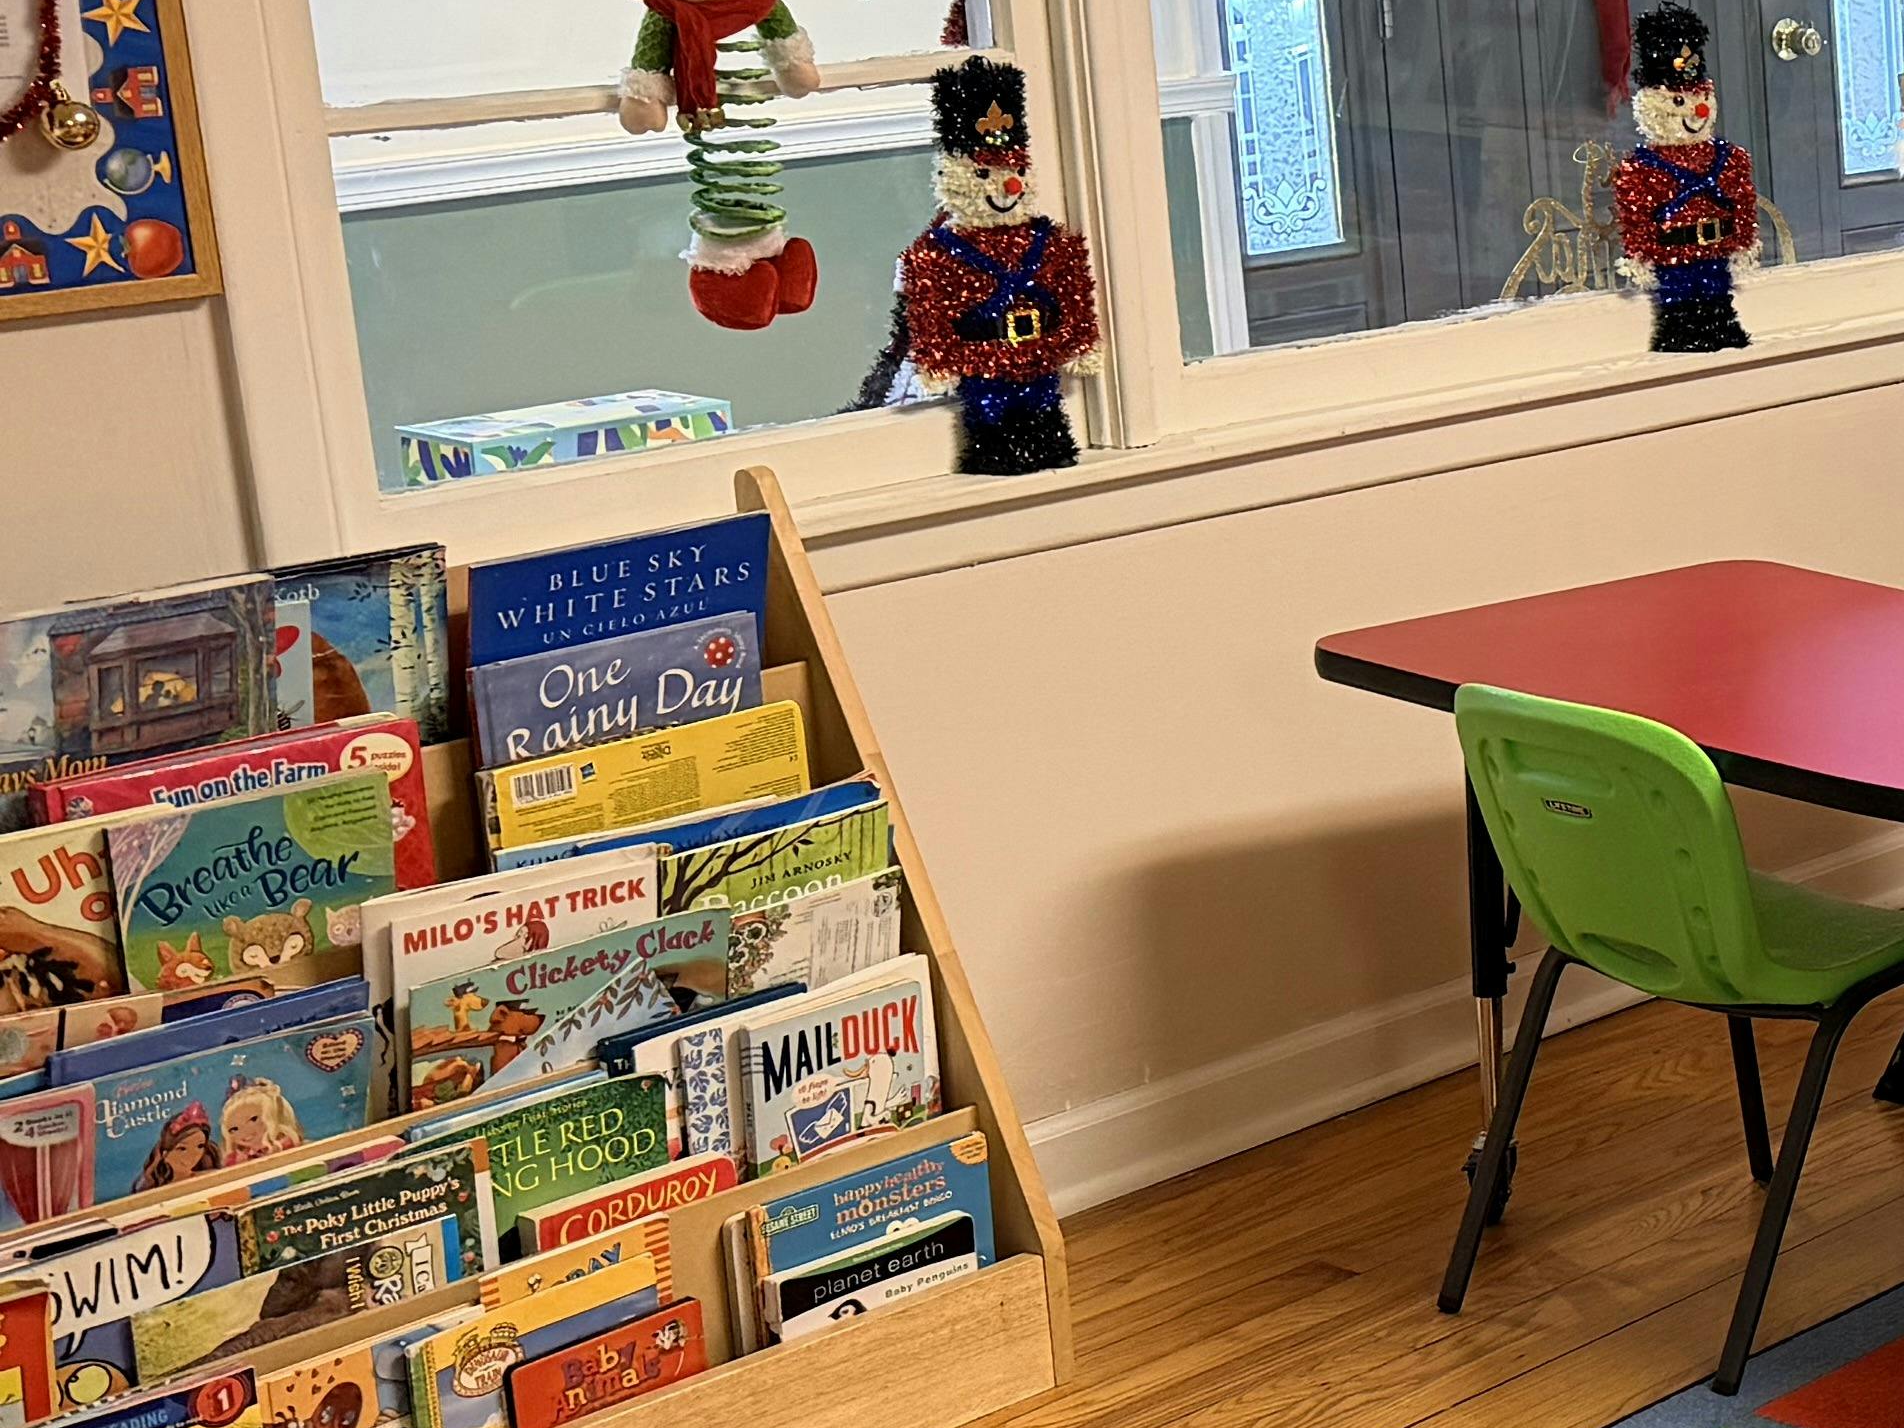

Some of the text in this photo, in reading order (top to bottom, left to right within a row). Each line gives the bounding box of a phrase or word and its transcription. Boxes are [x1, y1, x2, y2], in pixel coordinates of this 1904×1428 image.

[498, 561, 751, 630] WHITE STARS
[550, 544, 707, 591] BLUE SKY
[539, 657, 632, 709] One
[505, 668, 745, 762] Rainy Day
[152, 759, 328, 808] Fun on the Farm
[134, 824, 294, 927] Breathe
[253, 850, 360, 909] Bear
[751, 850, 853, 890] JIM ARNOSKY
[404, 876, 647, 956] MILO'S HAT TRICK
[506, 920, 716, 996] Clickety Clack
[549, 1128, 657, 1182] HOOD
[559, 1107, 625, 1150] RED
[305, 1176, 461, 1236] Poky Little Puppy's
[320, 1200, 449, 1250] First Christmas
[559, 1167, 717, 1247] CORDUROY
[836, 1174, 947, 1226] monsters
[812, 1241, 945, 1304] planet earth
[885, 1262, 970, 1299] Baby Penguins
[553, 1353, 663, 1424] Animals
[563, 1340, 638, 1385] Baby
